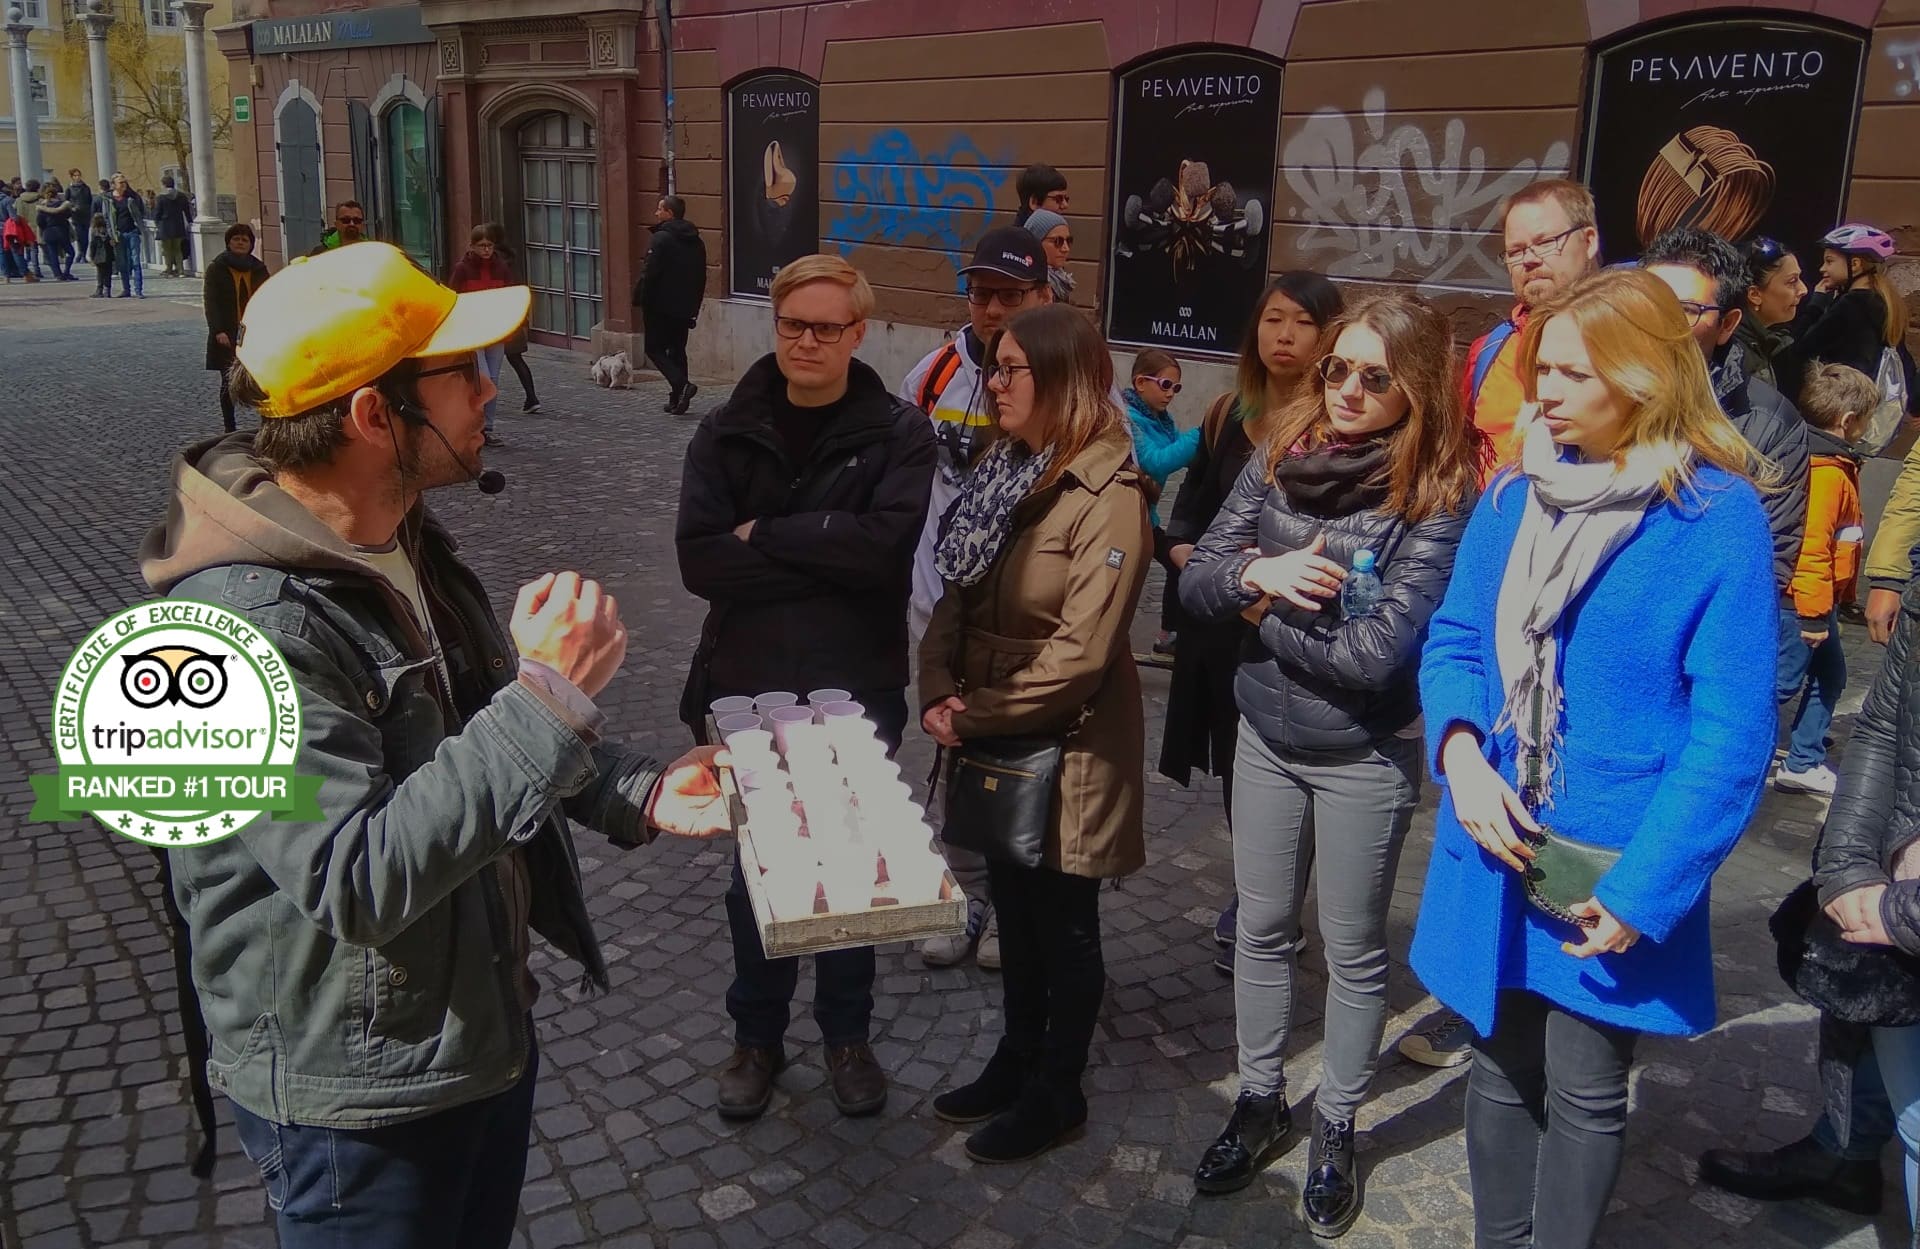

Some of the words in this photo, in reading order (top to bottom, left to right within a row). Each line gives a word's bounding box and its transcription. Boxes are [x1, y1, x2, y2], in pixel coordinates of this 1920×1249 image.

[273, 21, 332, 46] MALALAN
[1630, 51, 1823, 82] PESAVENTO
[1141, 75, 1261, 98] PESAVENTO
[742, 92, 811, 107] PESAVENTO
[1151, 320, 1217, 341] MALALAN
